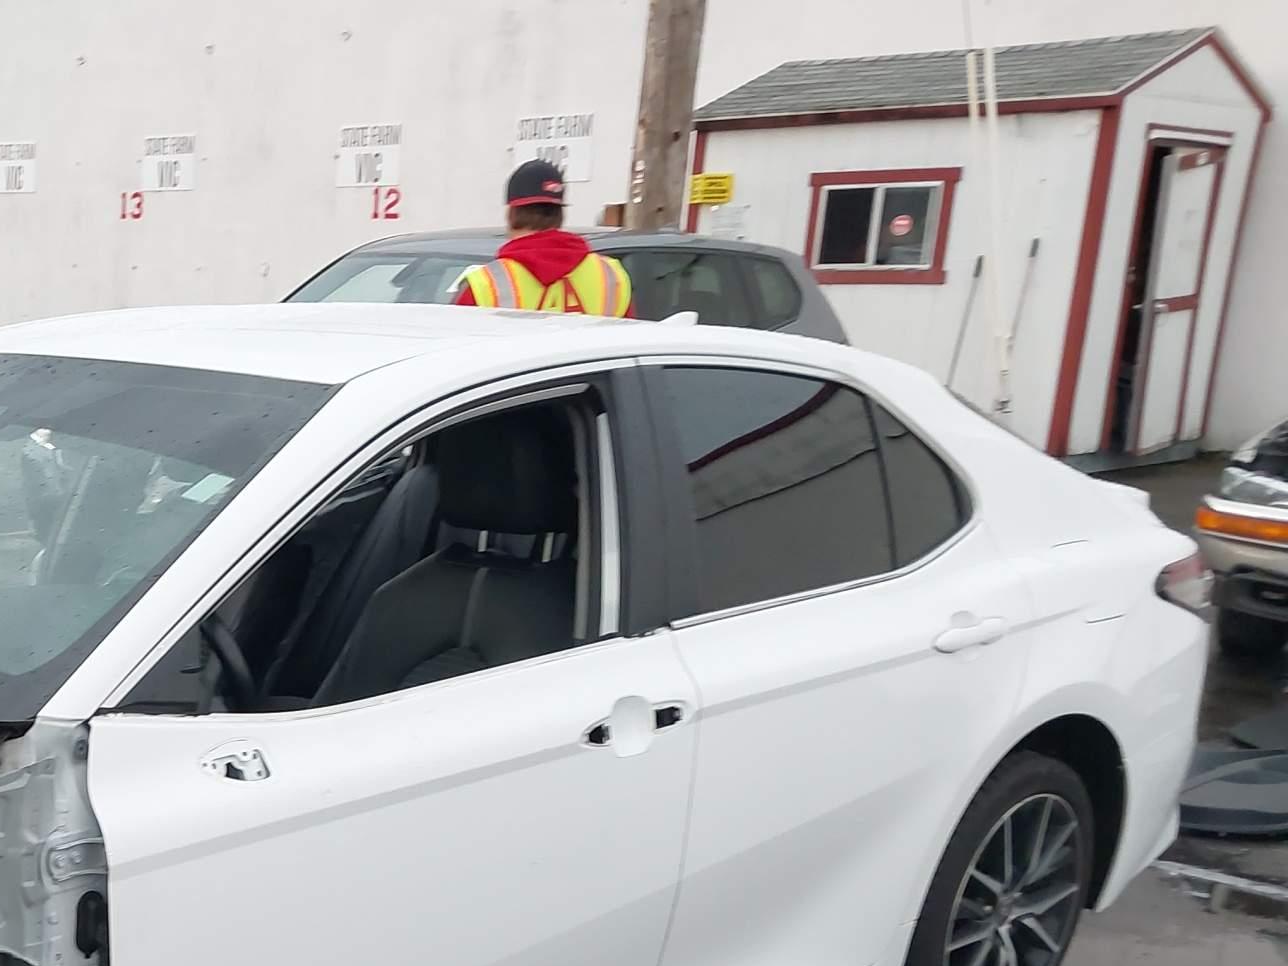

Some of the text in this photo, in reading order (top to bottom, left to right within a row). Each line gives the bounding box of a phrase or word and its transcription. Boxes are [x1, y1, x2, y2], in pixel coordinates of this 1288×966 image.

[341, 125, 401, 147] STATE FARM
[518, 113, 594, 141] STATE FARM
[119, 191, 144, 220] 13
[370, 187, 401, 220] 12
